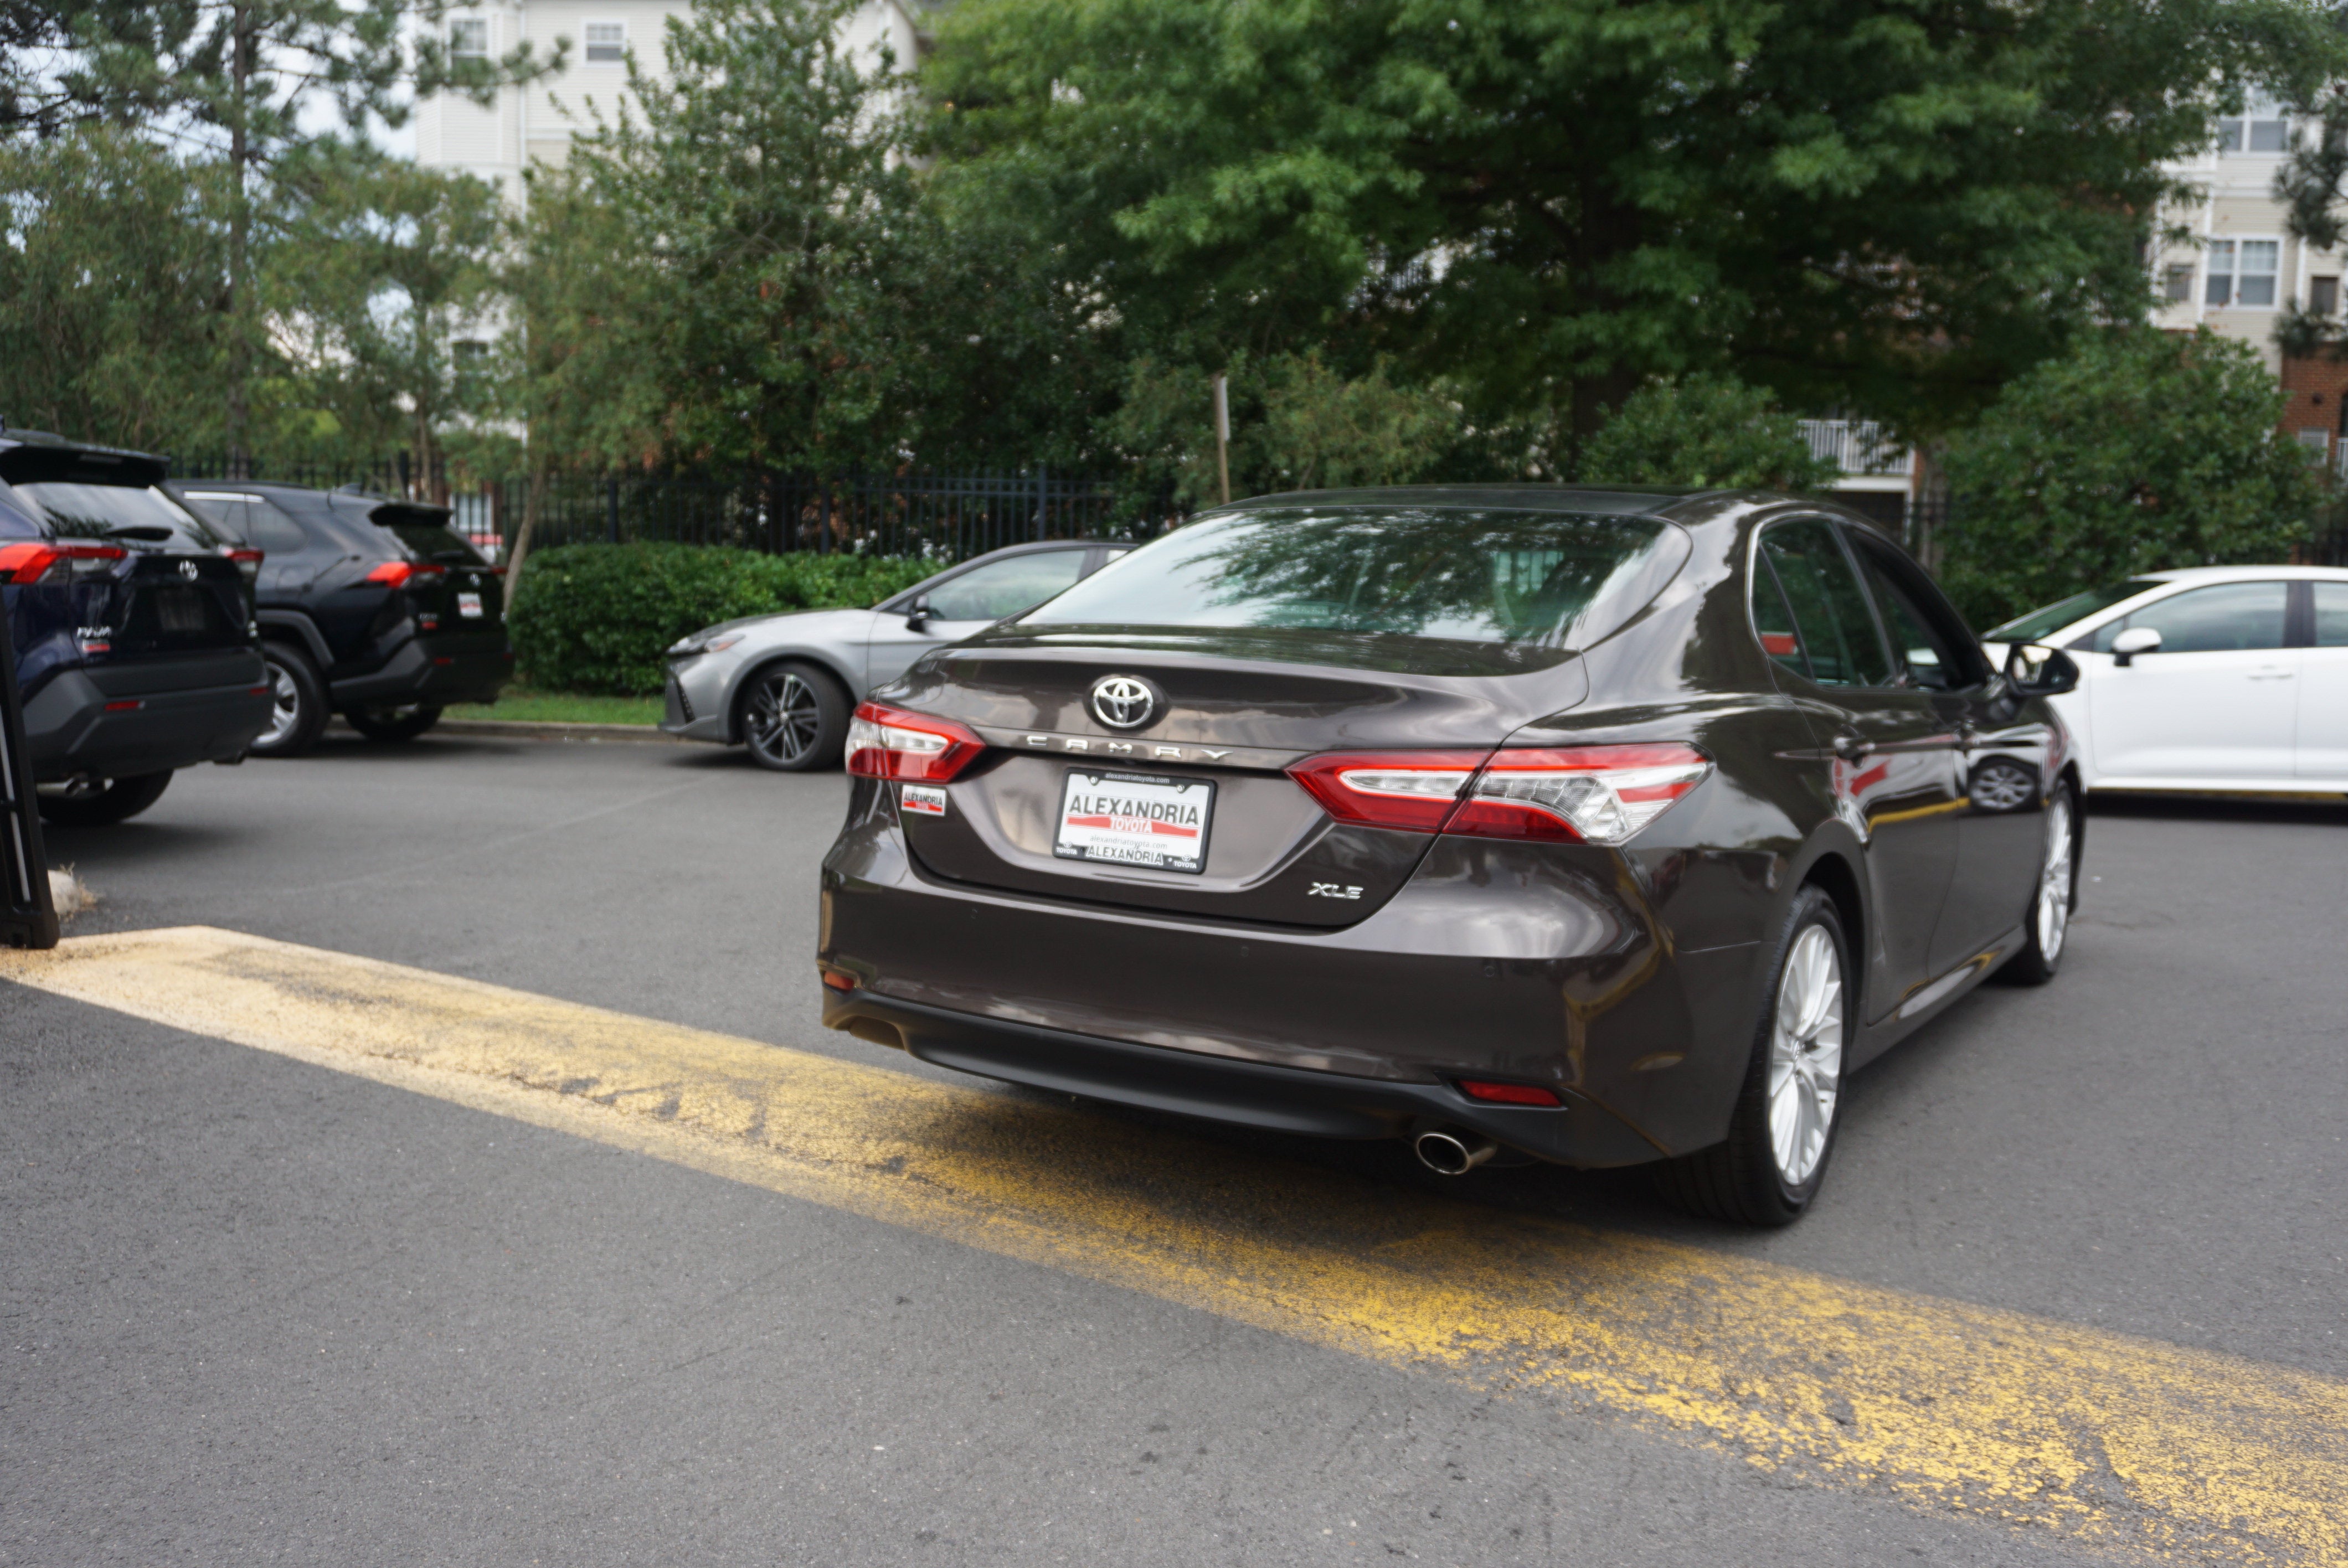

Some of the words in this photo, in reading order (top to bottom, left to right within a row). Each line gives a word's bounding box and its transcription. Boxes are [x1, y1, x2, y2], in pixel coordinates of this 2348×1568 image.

[1027, 735, 1234, 760] CAMRY
[1105, 772, 1170, 784] alexandriatoyota.com
[904, 792, 943, 806] ALEXANDRIA
[1069, 794, 1199, 825] ALEXANDRIA
[1110, 817, 1152, 833] TOYOTA
[1089, 835, 1167, 850] alexandriatoyota.com
[1056, 847, 1077, 855] TOYOTA
[1086, 845, 1163, 865] ALEXANDRIA
[1307, 881, 1363, 899] XLE
